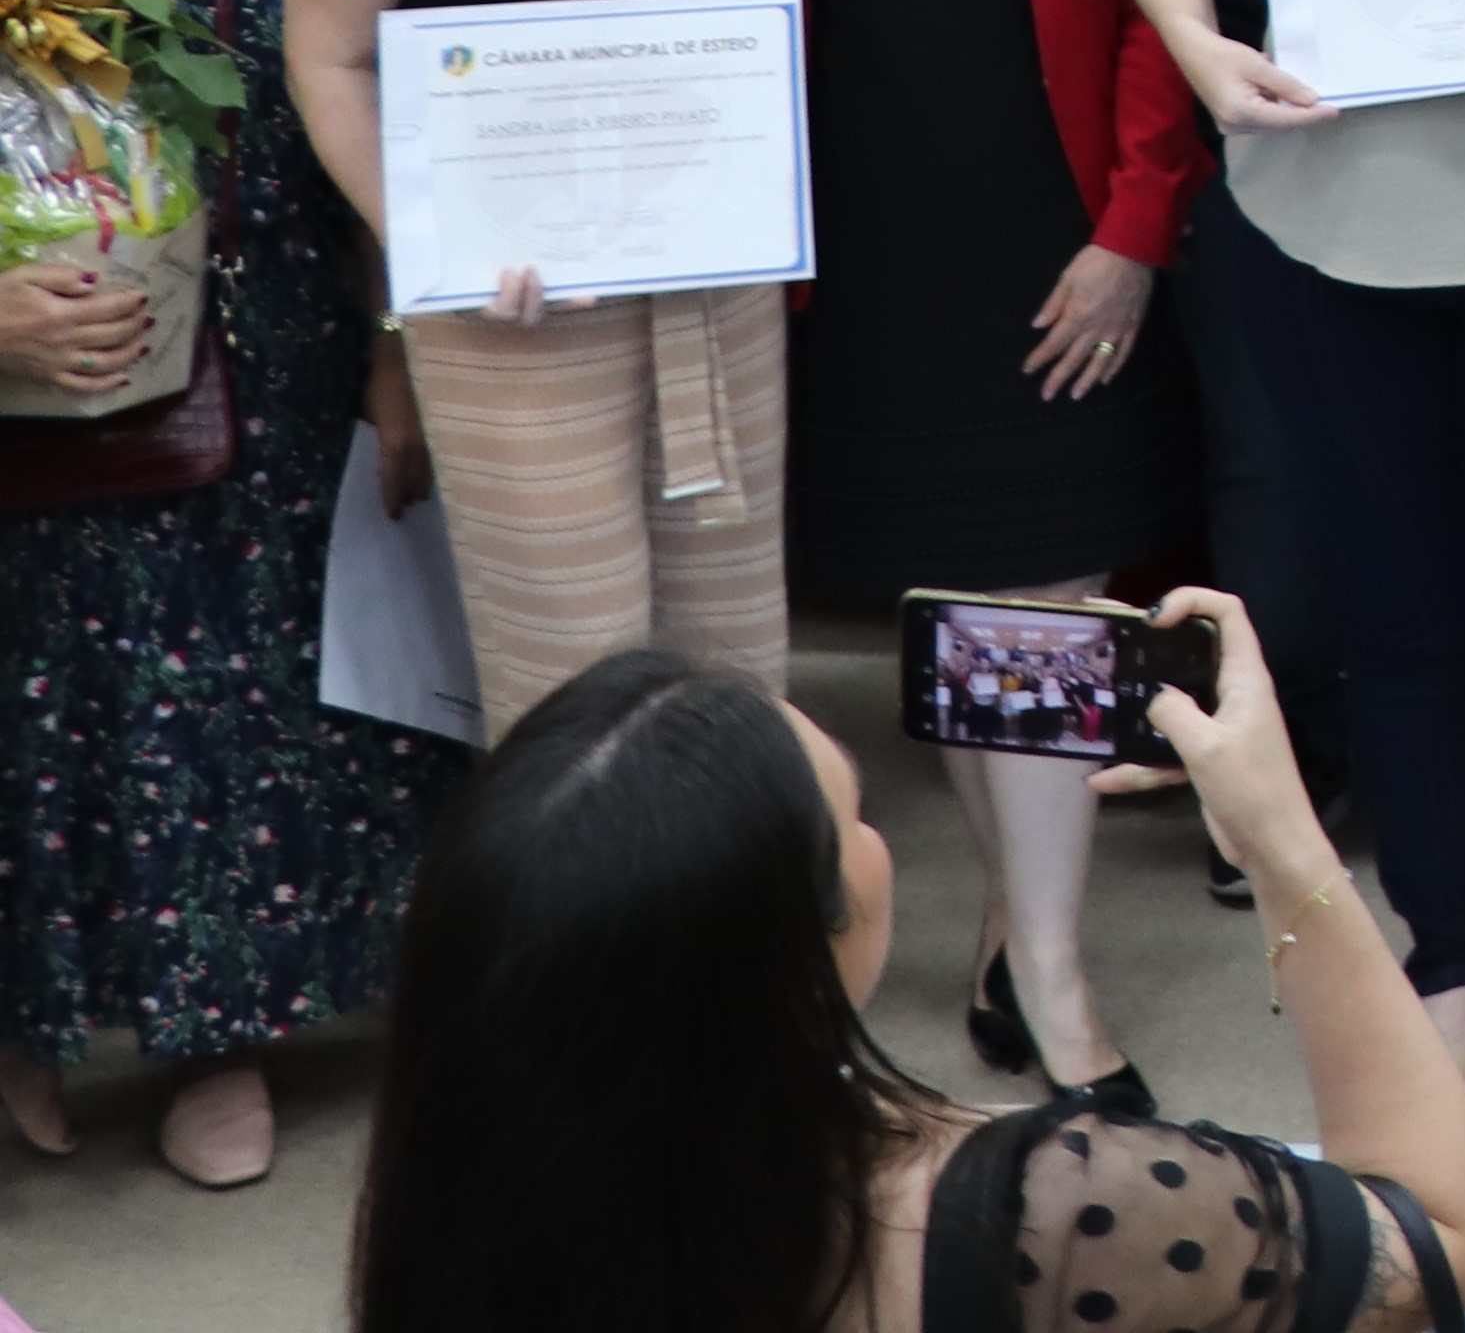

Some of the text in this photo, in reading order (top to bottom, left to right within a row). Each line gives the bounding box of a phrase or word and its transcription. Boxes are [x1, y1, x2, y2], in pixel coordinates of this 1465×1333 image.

[482, 34, 758, 68] CÂMARA MUNICIPAL DE ESTEIO
